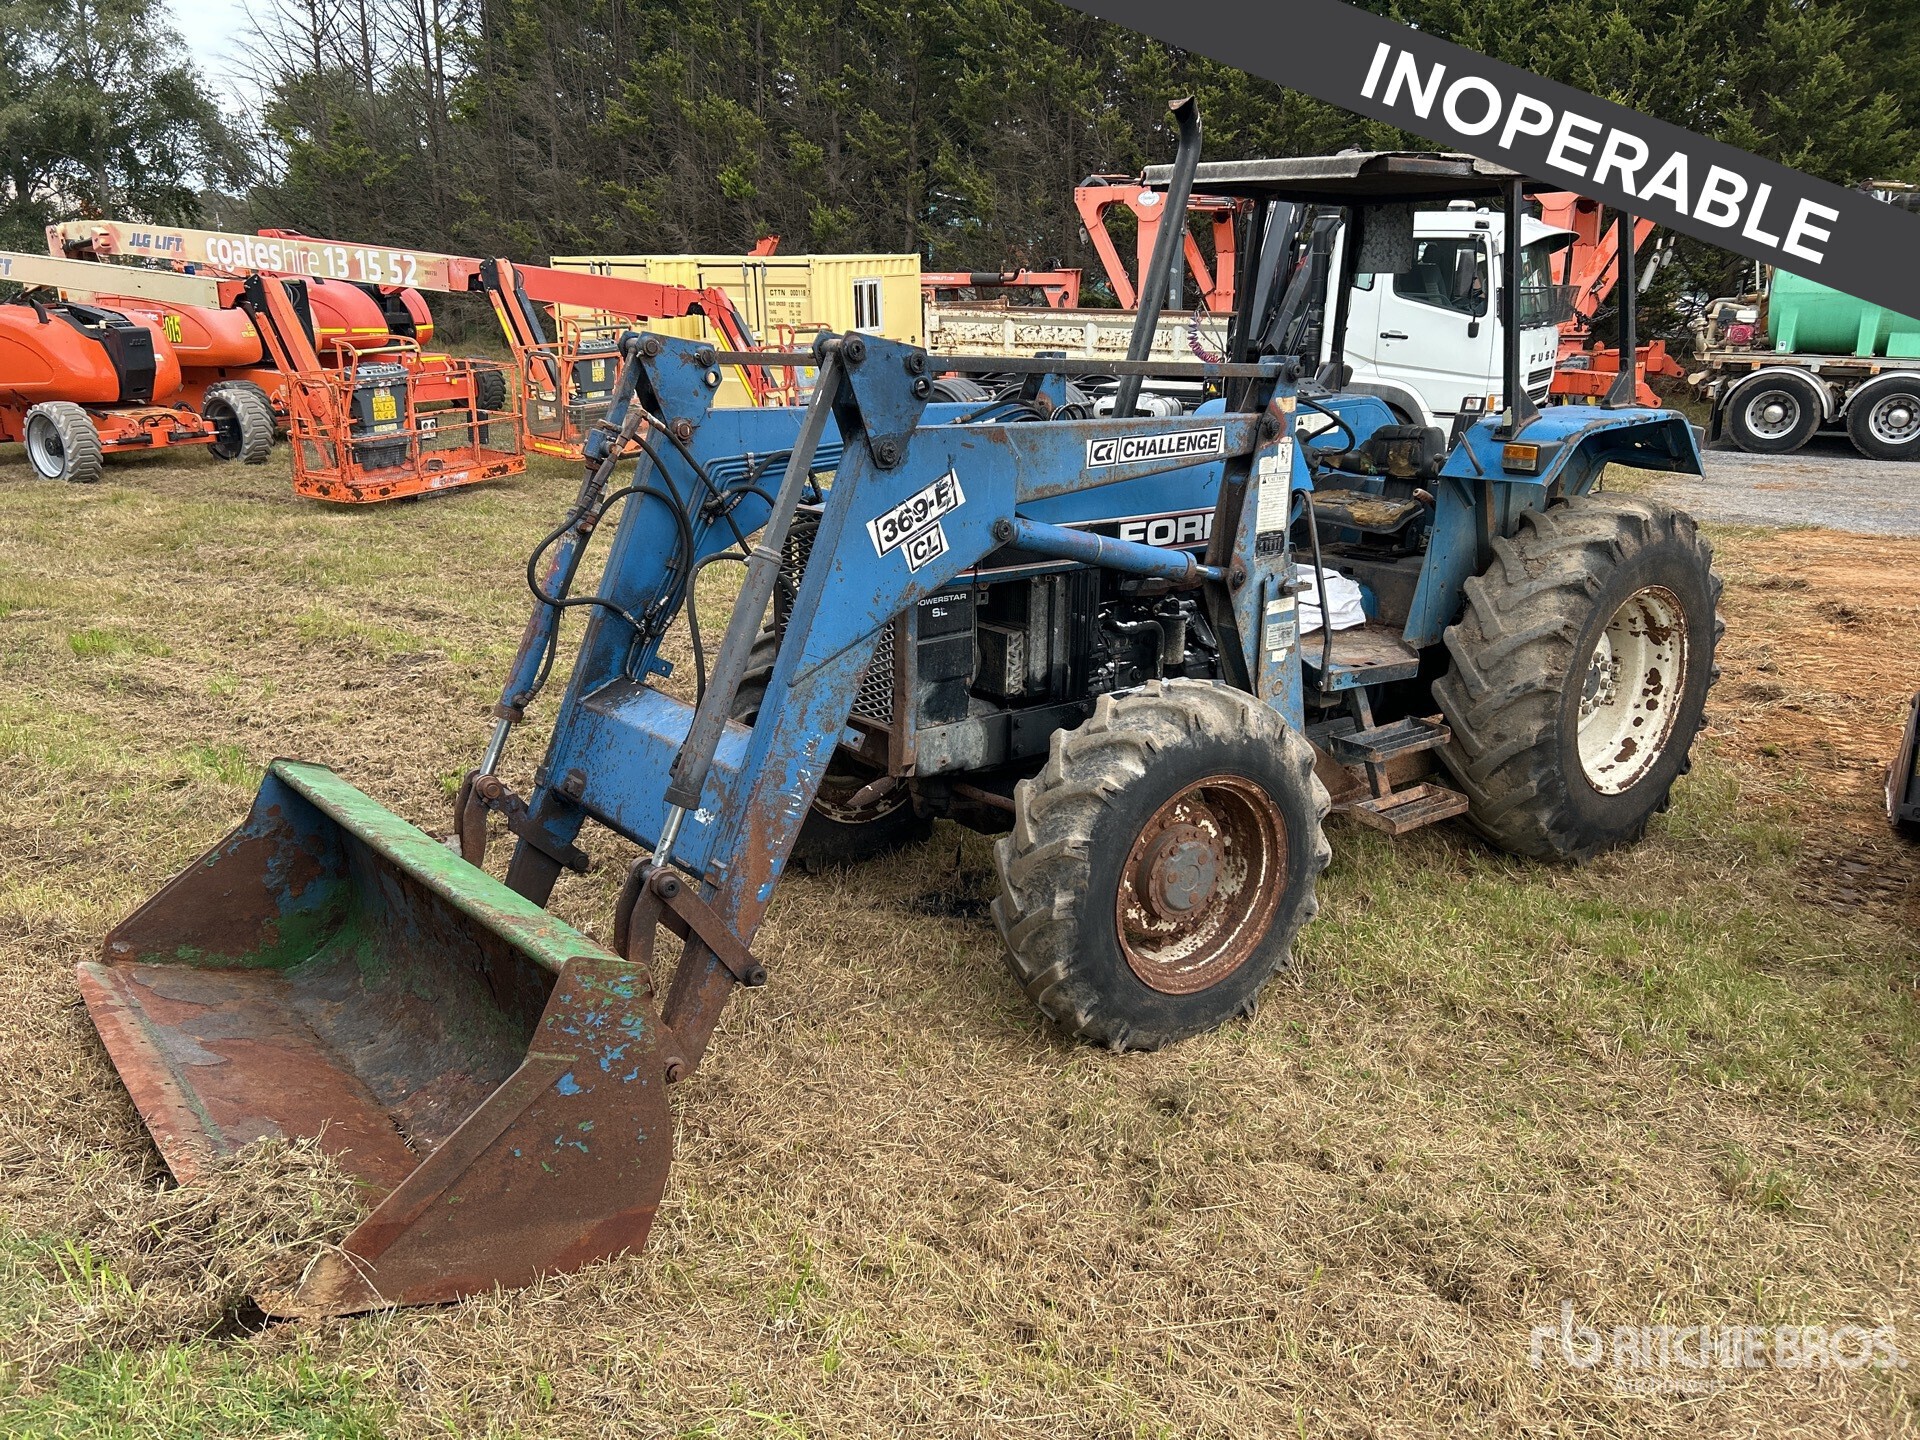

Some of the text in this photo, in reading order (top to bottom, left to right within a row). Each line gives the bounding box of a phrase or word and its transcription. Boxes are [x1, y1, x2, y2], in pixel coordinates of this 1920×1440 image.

[129, 232, 183, 251] JLG LIFT
[323, 246, 349, 278] 13
[354, 249, 383, 282] 15
[388, 253, 419, 286] 52
[1530, 350, 1555, 364] FUSO
[1123, 433, 1219, 458] CHALLENGE
[882, 479, 952, 543] 369-E
[913, 535, 939, 560] CL
[917, 593, 967, 606] OWERSTAR
[932, 607, 948, 617] SL
